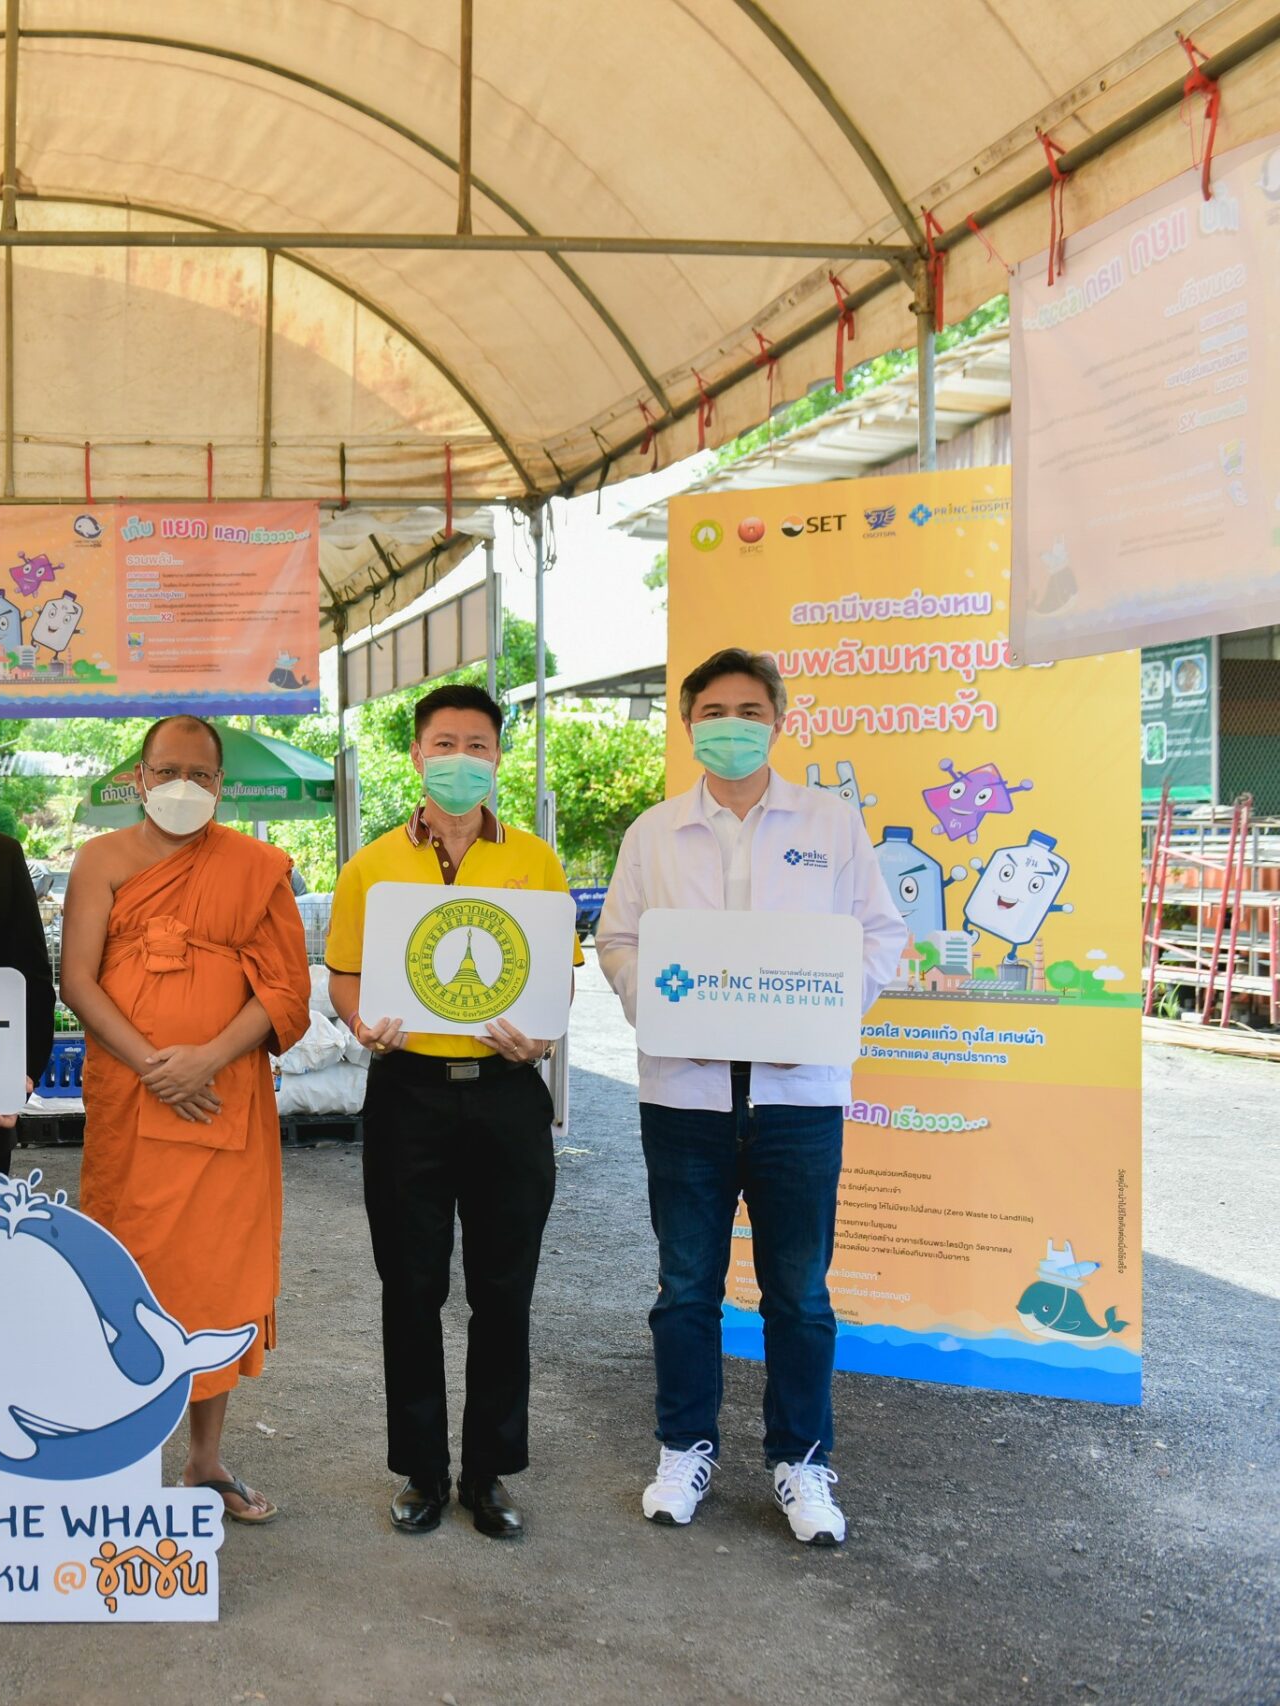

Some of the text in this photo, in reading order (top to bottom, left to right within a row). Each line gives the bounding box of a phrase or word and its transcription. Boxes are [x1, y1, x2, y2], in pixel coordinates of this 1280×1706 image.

[971, 501, 1012, 512] HOSPIT
[162, 519, 207, 537] แยก
[214, 525, 248, 542] แลก
[806, 515, 847, 533] SET
[792, 587, 991, 623] สถานีขยะล่องหน
[786, 689, 995, 745] คุ้งบางกะเจ้า
[435, 904, 507, 927] วัดจากแดง
[758, 977, 844, 994] HOSPITAL
[697, 990, 844, 1007] SUVARNABHUMI
[904, 1025, 958, 1041] ขวดแก้ว
[961, 1028, 994, 1044] ถุงใส
[999, 1028, 1043, 1044] เศษผ้า
[871, 1047, 929, 1060] วัดจากแดง
[932, 1050, 1006, 1064] สมุทรปราการ
[61, 1505, 214, 1538] WHALE
